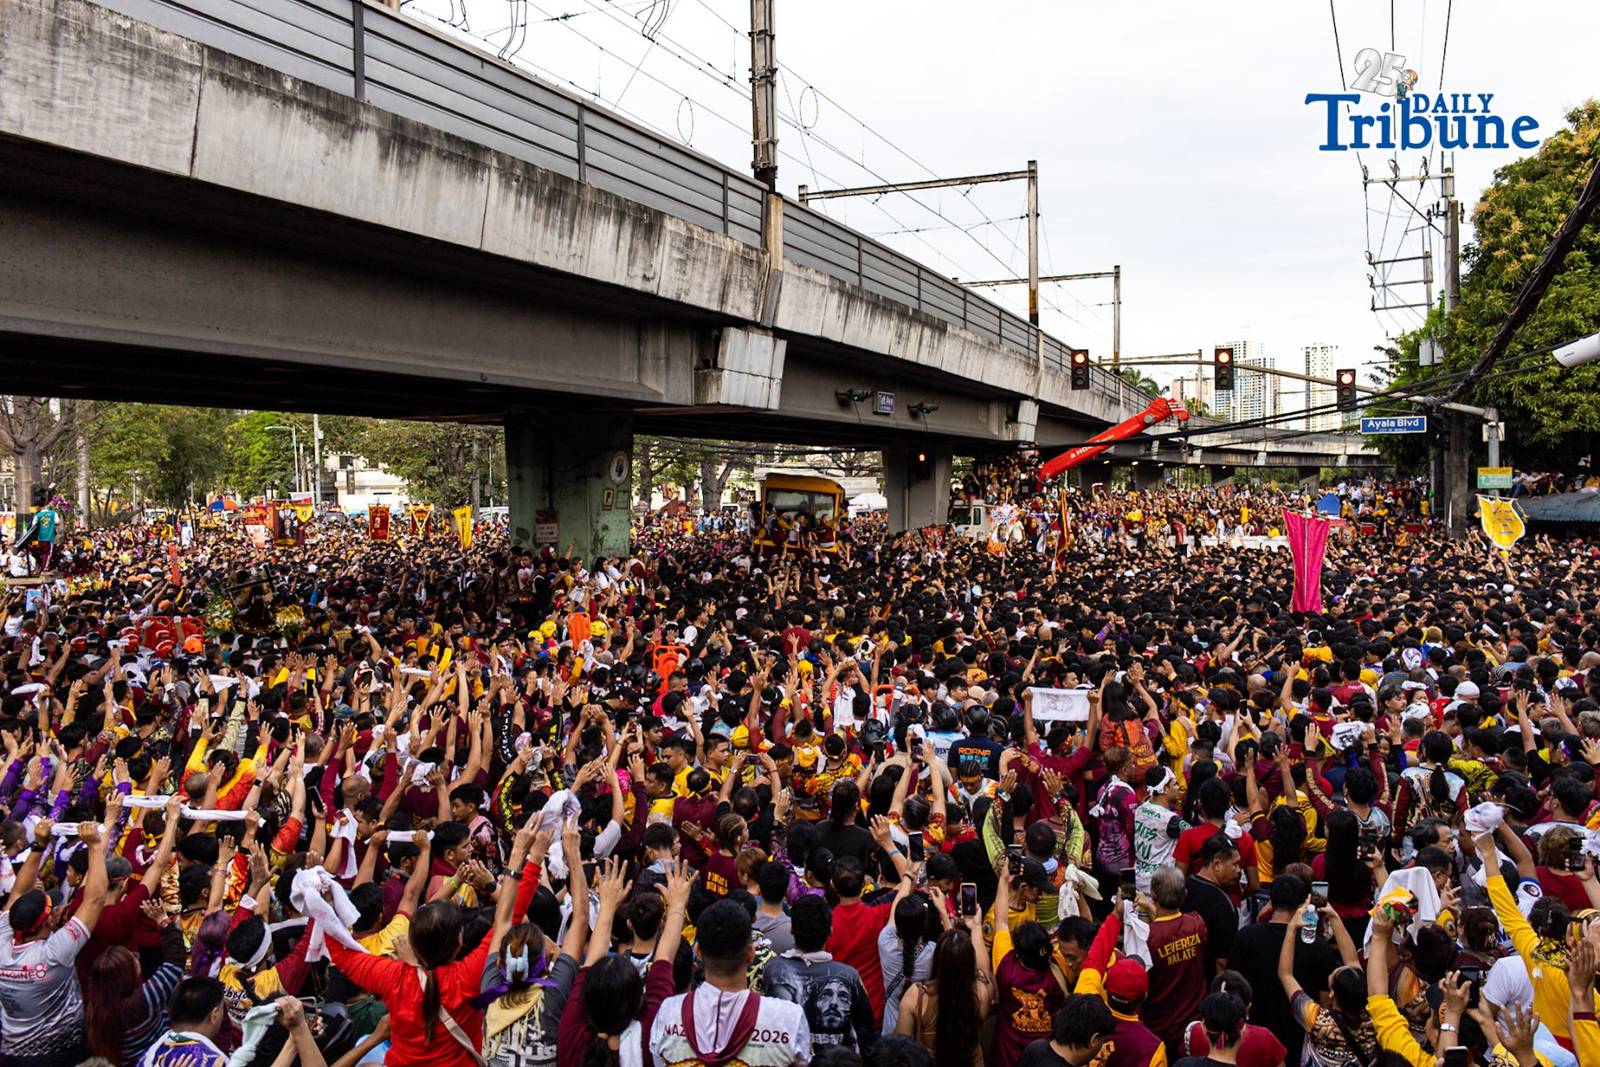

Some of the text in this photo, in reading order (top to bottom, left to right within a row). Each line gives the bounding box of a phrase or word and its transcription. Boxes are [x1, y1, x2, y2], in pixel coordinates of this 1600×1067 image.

[1367, 418, 1419, 430] Ayala Blvd
[751, 1029, 790, 1044] 2026
